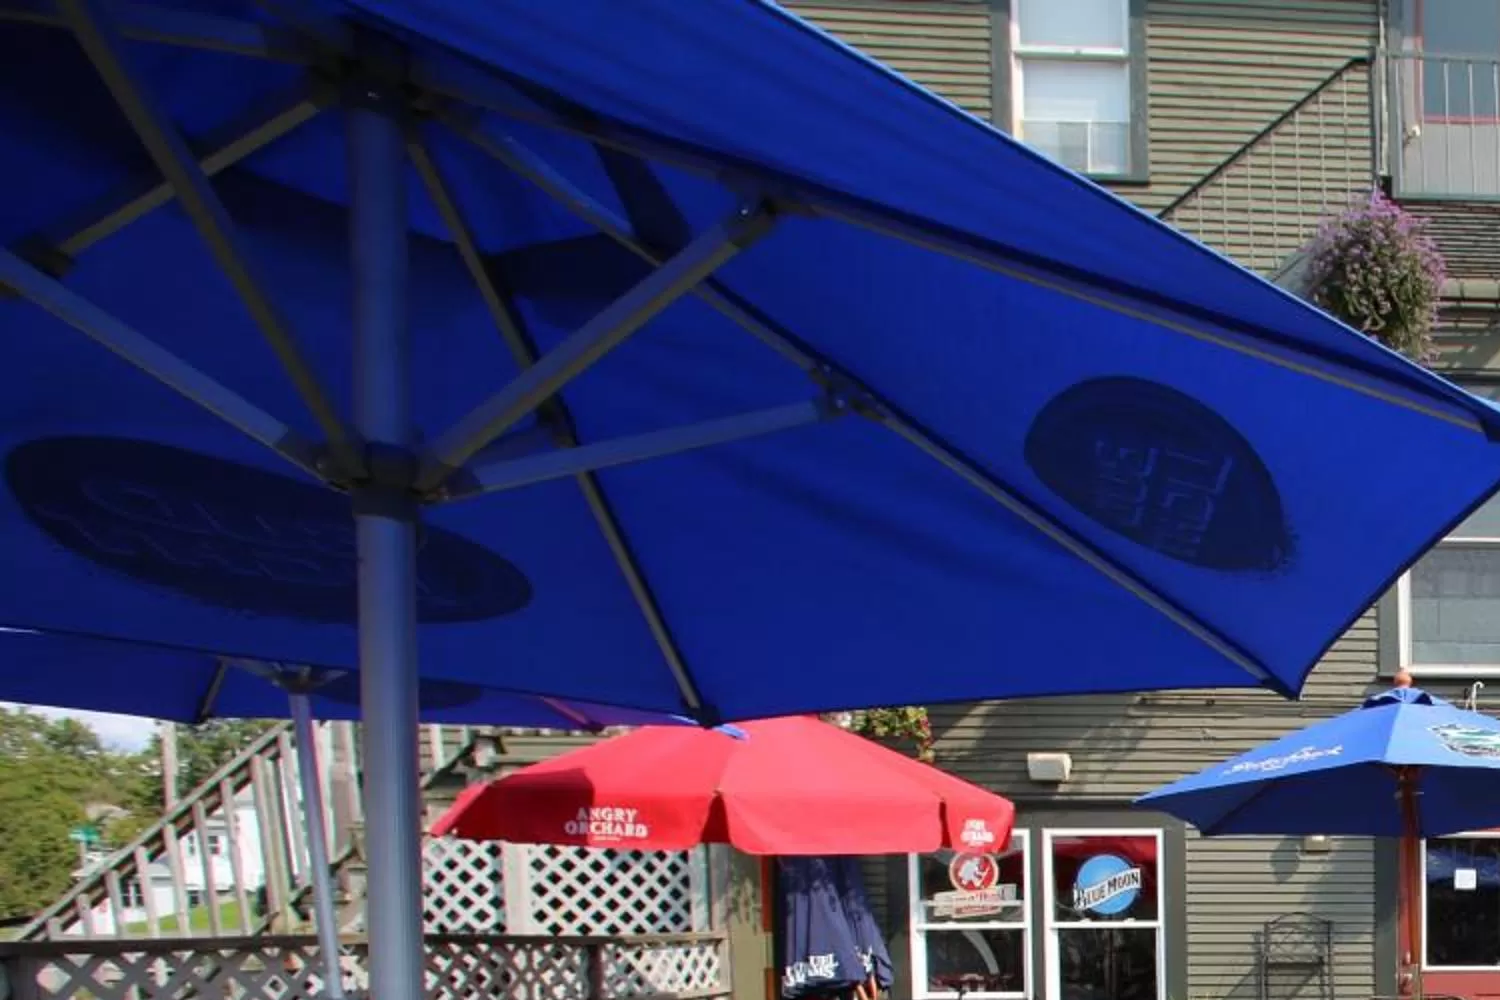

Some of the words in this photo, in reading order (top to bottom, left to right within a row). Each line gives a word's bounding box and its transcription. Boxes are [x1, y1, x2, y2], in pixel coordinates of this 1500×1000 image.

[576, 807, 638, 823] ANGRY
[563, 821, 649, 838] ORCHARD
[1107, 871, 1139, 893] MOON
